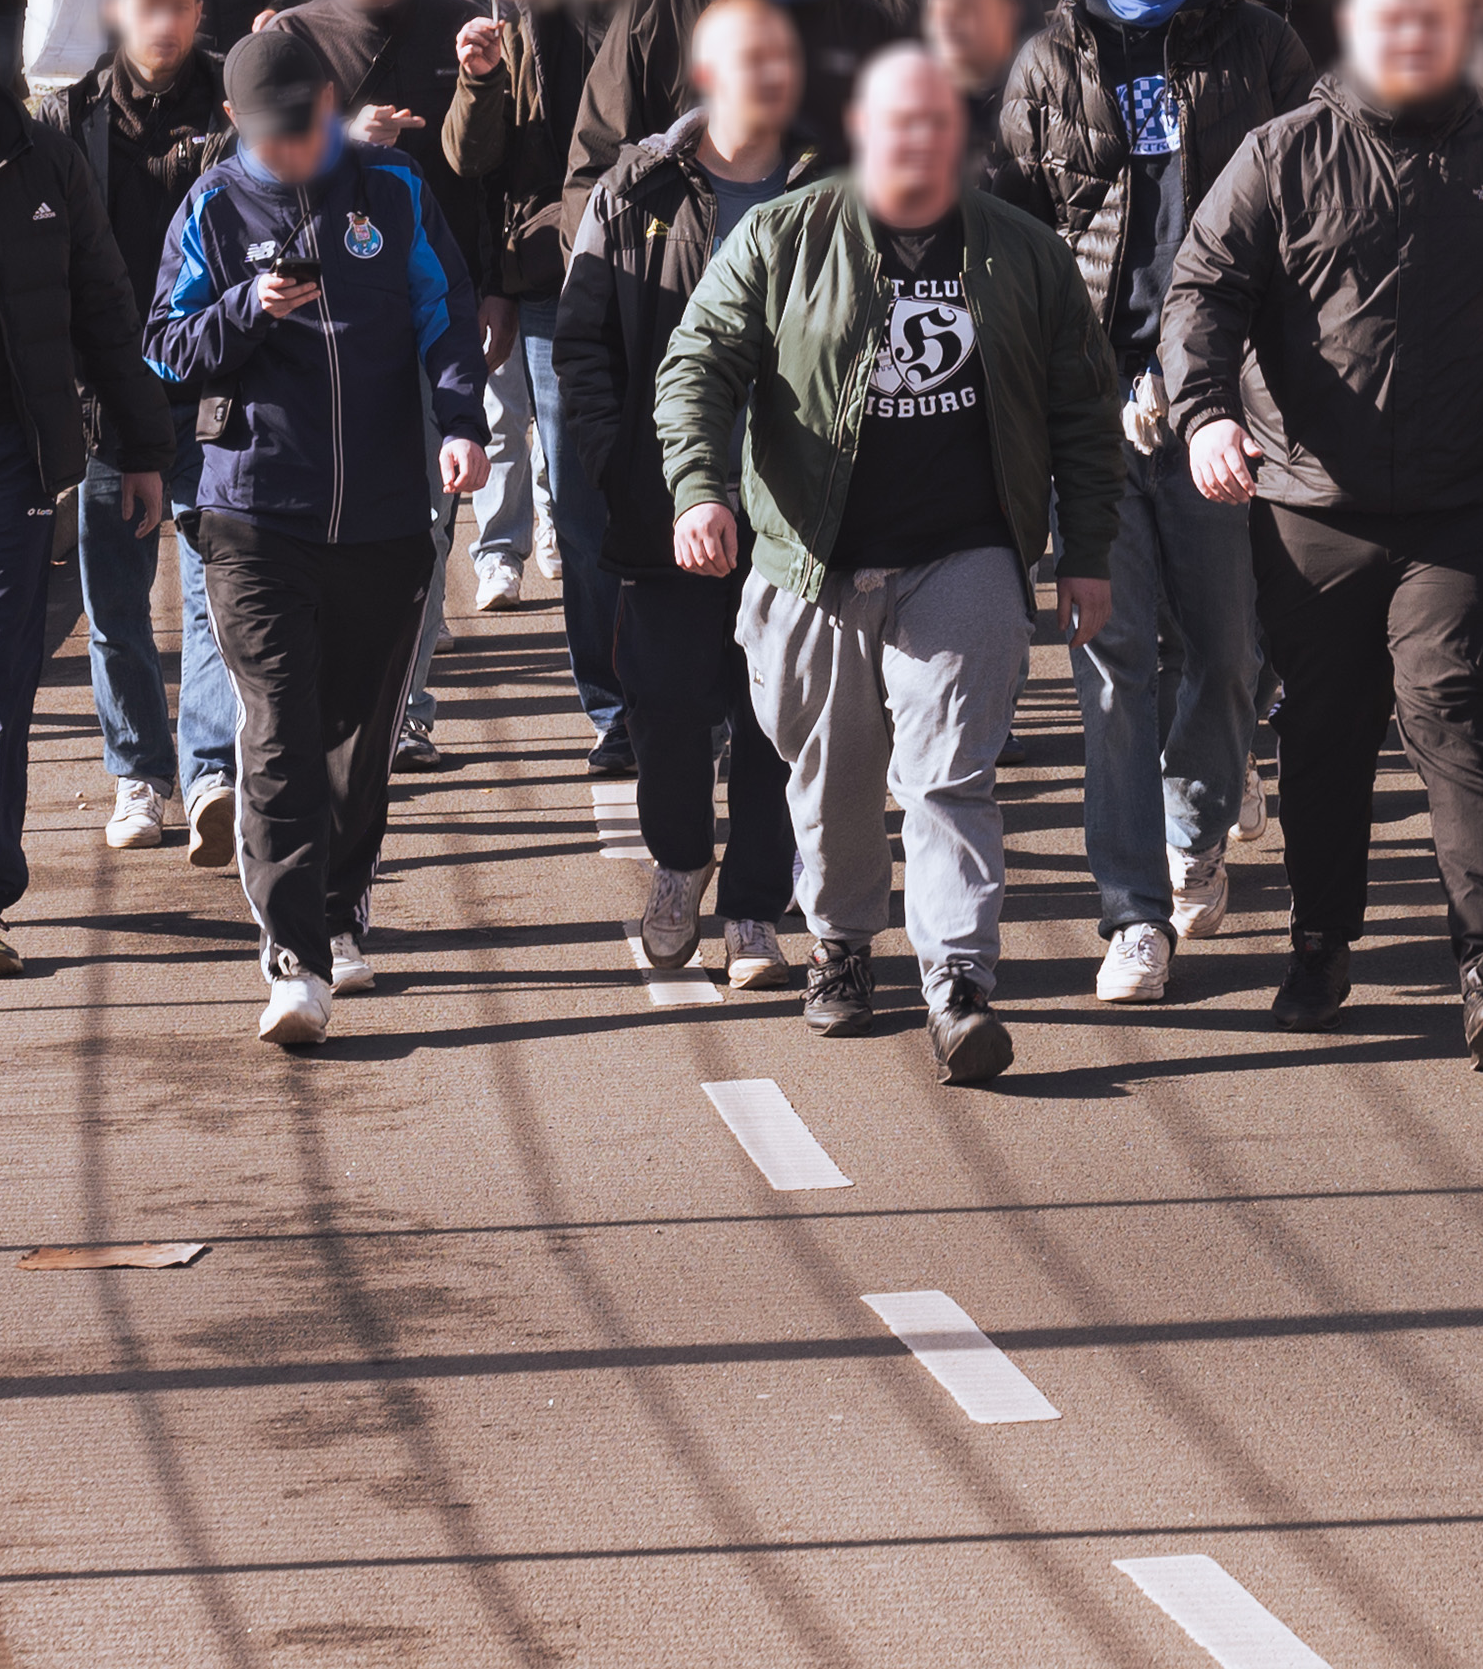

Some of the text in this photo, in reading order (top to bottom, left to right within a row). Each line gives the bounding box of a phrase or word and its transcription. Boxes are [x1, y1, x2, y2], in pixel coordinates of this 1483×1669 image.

[32, 211, 56, 221] adidas
[914, 279, 963, 299] CLU
[864, 386, 977, 419] ISBURG
